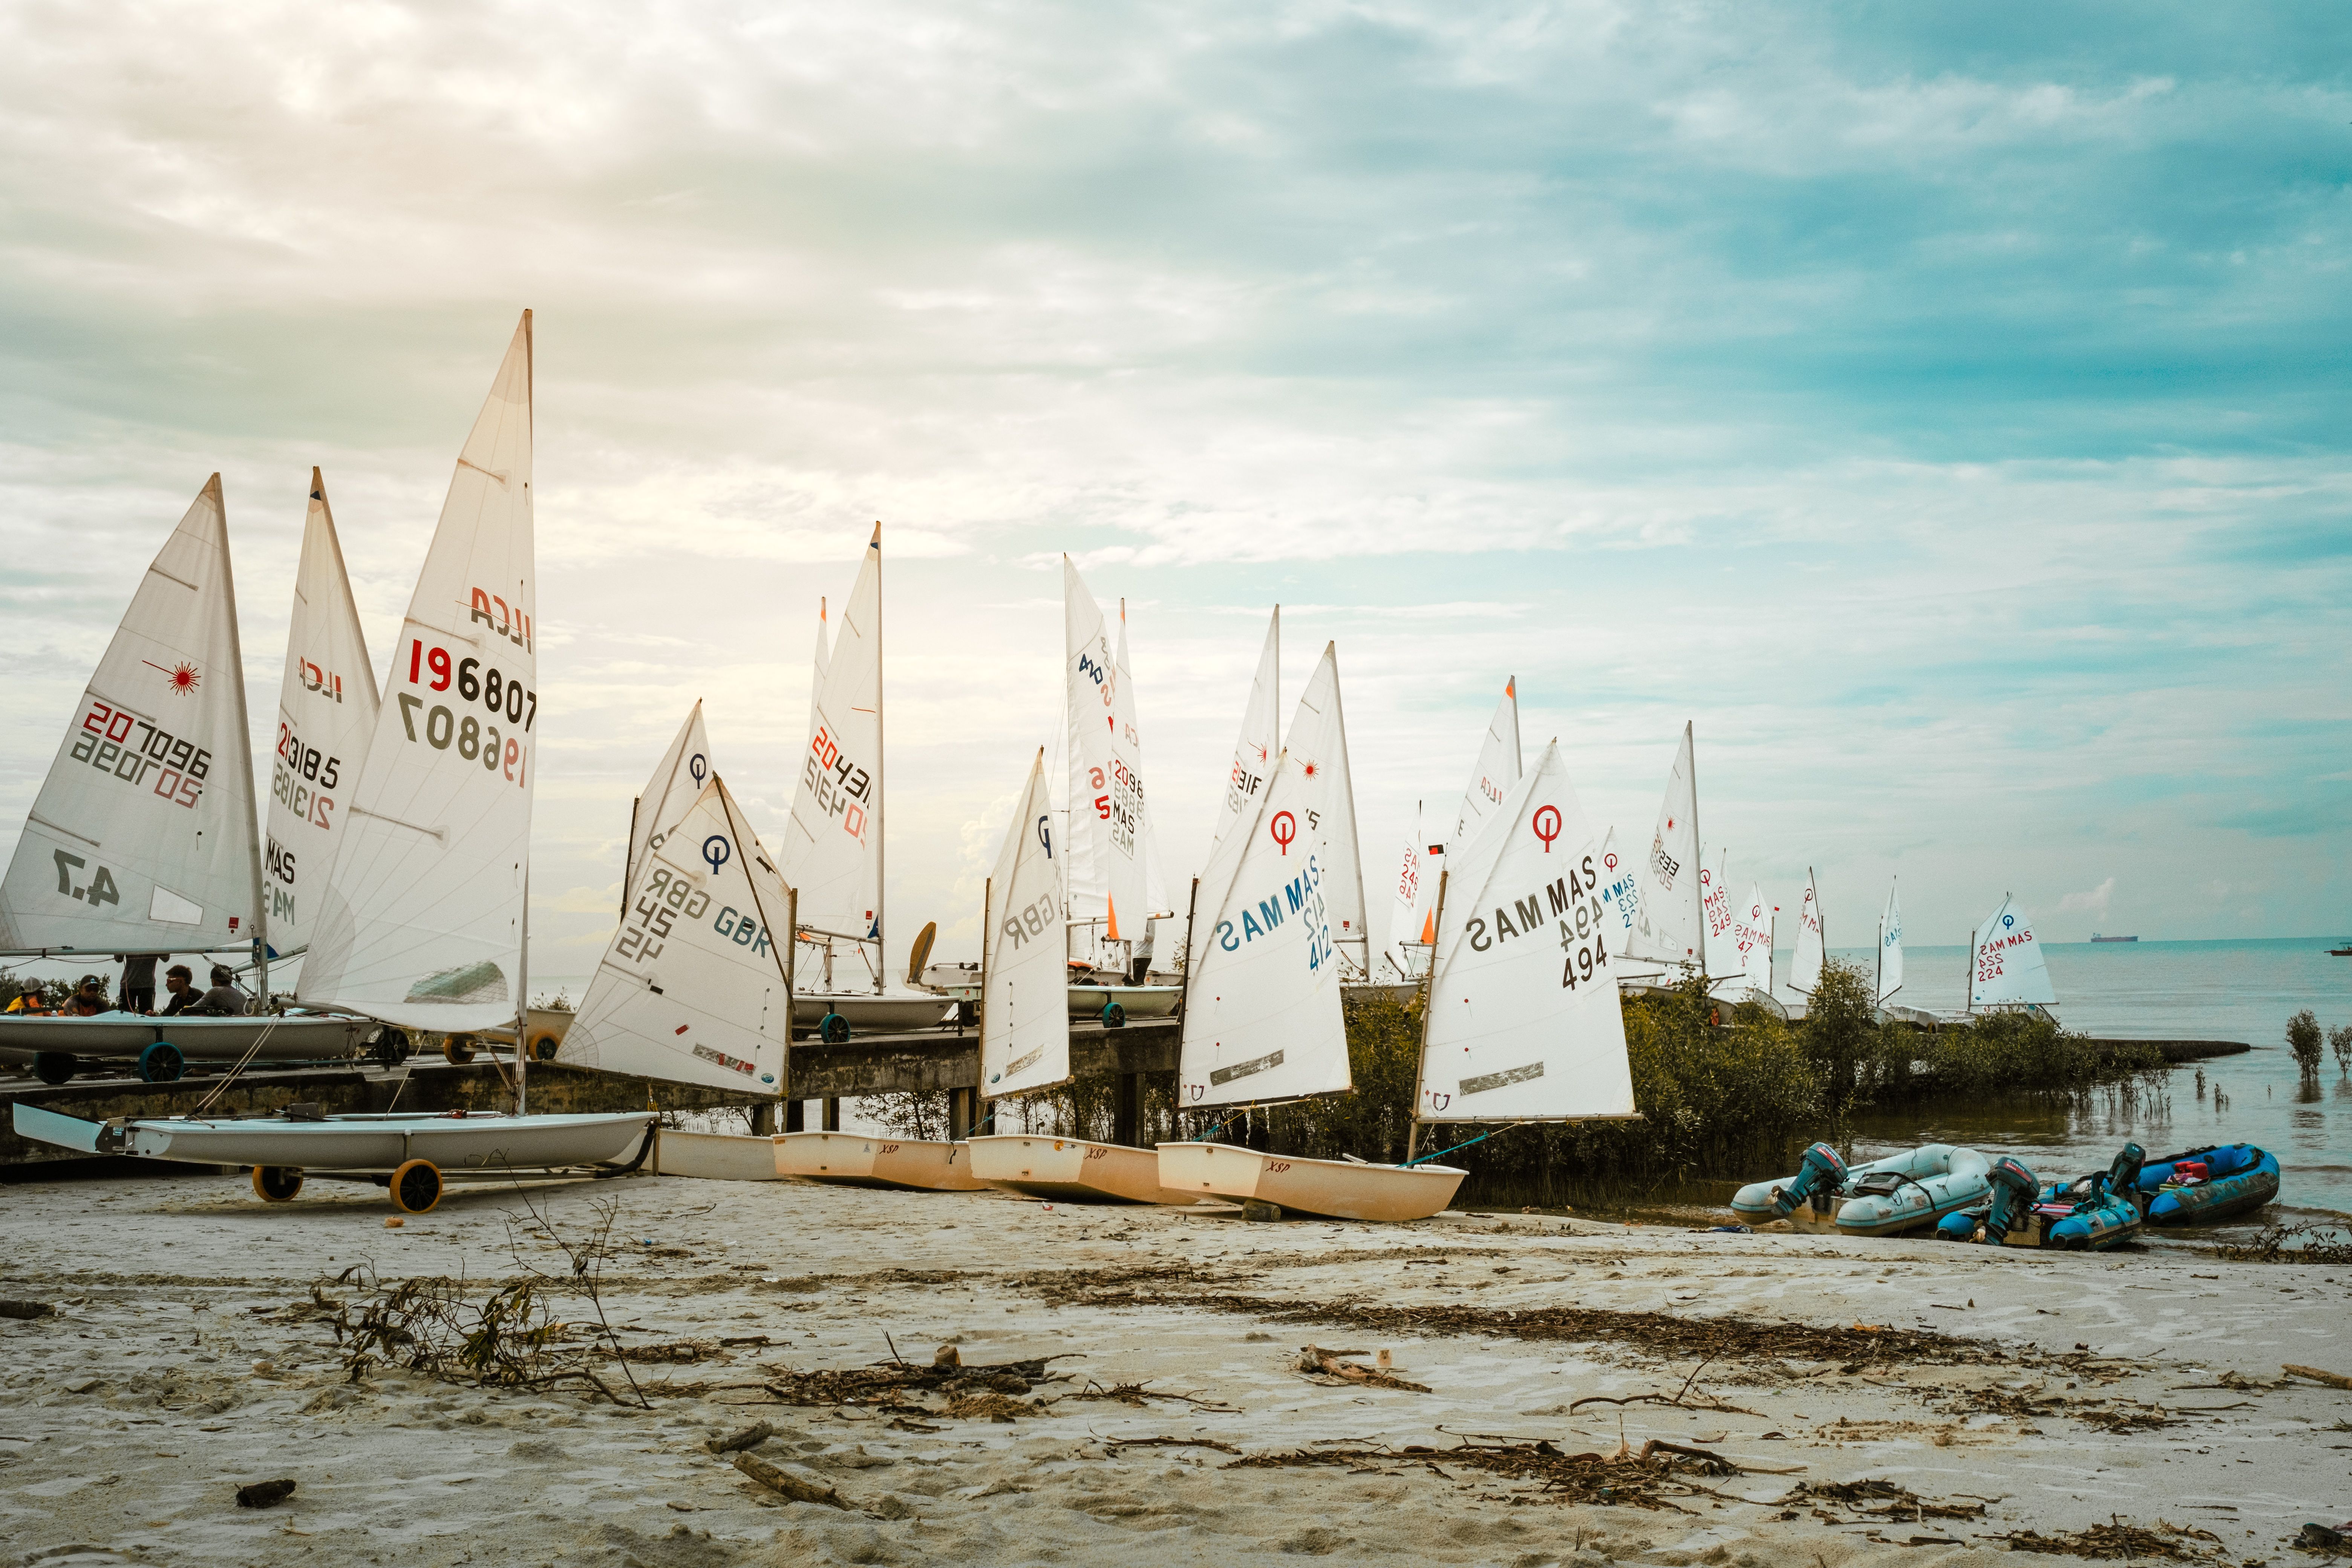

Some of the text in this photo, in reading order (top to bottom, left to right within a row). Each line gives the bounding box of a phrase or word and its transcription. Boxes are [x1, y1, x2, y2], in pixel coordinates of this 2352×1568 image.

[1079, 653, 1103, 684] 420
[409, 639, 536, 733] 196807
[83, 702, 211, 780] 207096
[278, 722, 340, 789] 213185
[1115, 759, 1144, 805] 2098
[1113, 799, 1135, 834] MAS
[266, 838, 295, 884] MAS
[1285, 854, 1319, 915] MAS
[1401, 864, 1418, 891] 246
[1546, 855, 1596, 917] MAS
[1612, 874, 1634, 898] MAS
[1704, 886, 1724, 910] MAS
[635, 896, 678, 939] 45
[714, 906, 773, 958] GBR
[1712, 913, 1731, 937] 249
[1309, 924, 1332, 972] 412
[1736, 938, 1753, 953] 47
[2007, 930, 2032, 947] MAS
[1562, 934, 1607, 991] 494
[1978, 966, 2003, 982] 224
[879, 1144, 899, 1155] XSP
[1084, 1147, 1107, 1160] XSP
[1825, 1149, 1837, 1160] YAMAHA
[1265, 1161, 1291, 1173] XSP
[2011, 1161, 2025, 1173] YAMAHA
